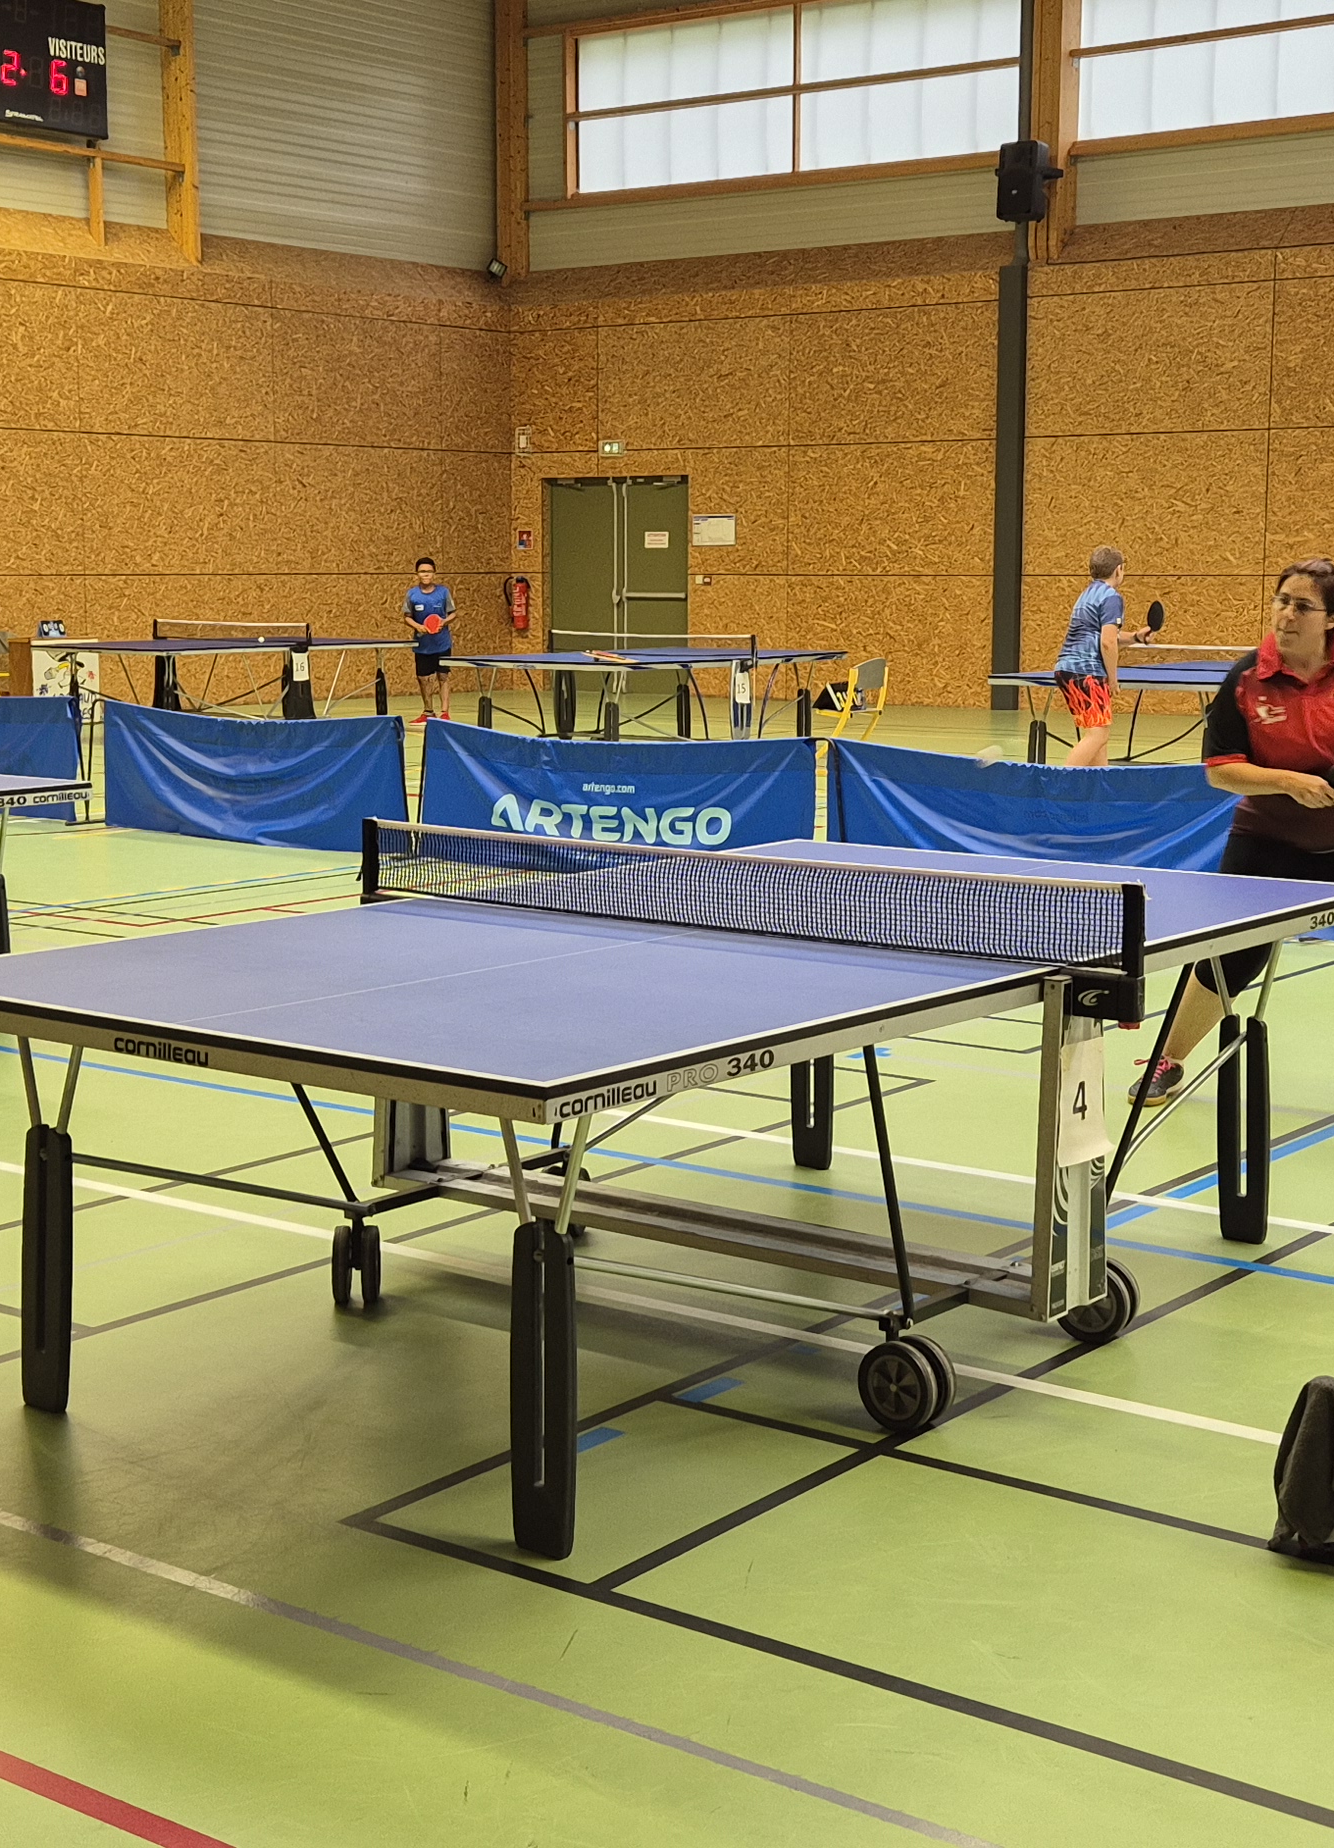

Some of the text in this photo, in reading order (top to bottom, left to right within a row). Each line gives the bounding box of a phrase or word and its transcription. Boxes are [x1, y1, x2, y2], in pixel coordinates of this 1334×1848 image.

[48, 37, 106, 65] VISITEURS
[0, 49, 21, 86] 2
[50, 59, 68, 96] 6
[295, 661, 305, 672] 16
[737, 683, 747, 694] 15
[32, 791, 88, 804] cornilleau
[582, 781, 636, 795] artengo.com
[490, 792, 732, 847] ARTENGO
[113, 1036, 210, 1068] cornilleau
[558, 1049, 775, 1119] cornilleau PRO 340
[1072, 1080, 1089, 1121] 4
